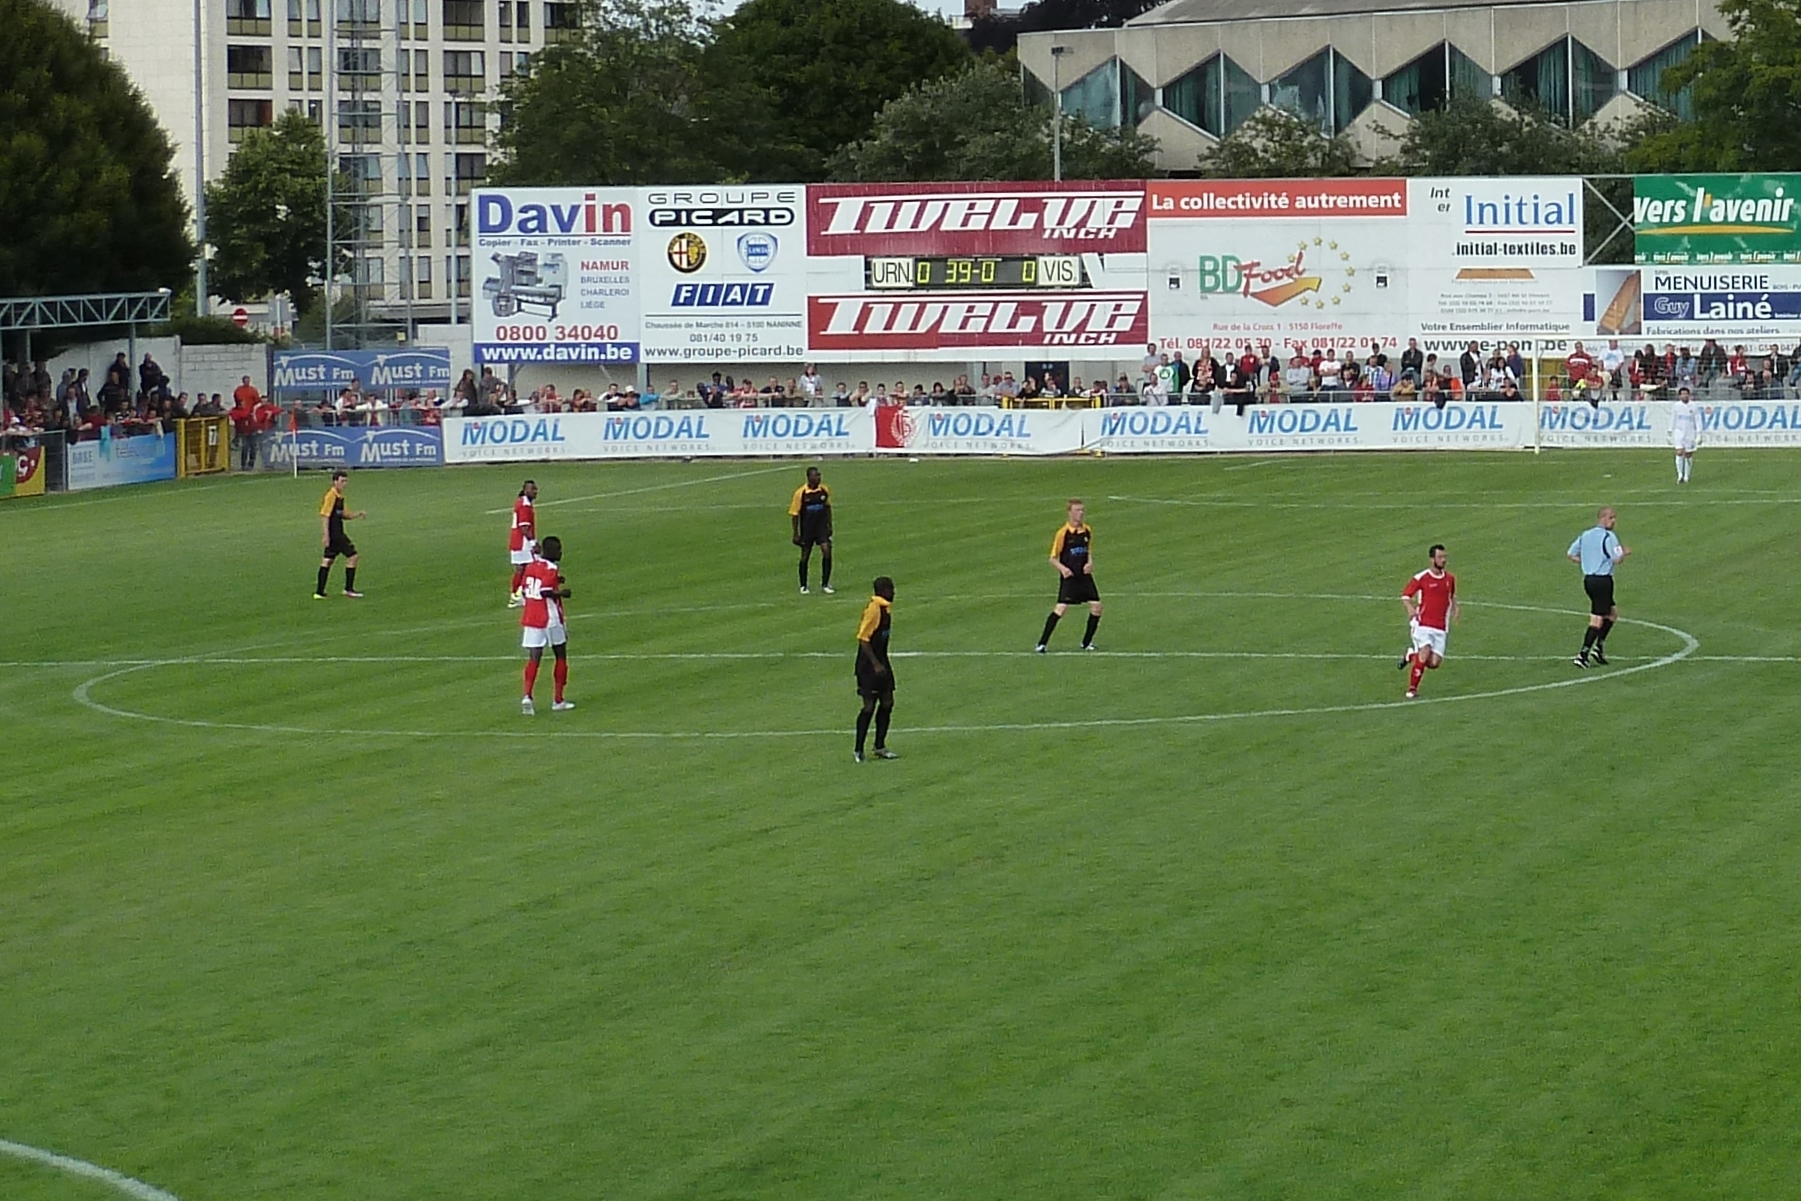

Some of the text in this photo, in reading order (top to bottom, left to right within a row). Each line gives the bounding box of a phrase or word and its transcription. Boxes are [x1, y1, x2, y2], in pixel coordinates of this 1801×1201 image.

[648, 192, 796, 204] GROUPE
[1152, 192, 1401, 209] La collectivité autrement
[1634, 187, 1794, 223] vers l'avenir
[478, 193, 632, 233] Davin
[654, 210, 791, 224] PICARD
[1465, 193, 1575, 225] Initial
[1043, 228, 1117, 239] INCH
[479, 238, 511, 248] Copier
[591, 238, 631, 246] Scanner
[581, 261, 629, 270] NAMUR
[873, 261, 913, 283] URN.
[918, 261, 1035, 283] 0 0
[581, 276, 630, 284] BRUXELLES
[1655, 276, 1769, 290] MENUISERIE
[581, 288, 629, 296] CHARLEROI
[677, 285, 773, 304] FIAT
[1654, 294, 1772, 319] Guy Lainé
[496, 325, 618, 341] 0800 34040
[1213, 323, 1228, 331] Rue
[1243, 322, 1250, 330] la
[1311, 322, 1342, 330] Floreffe
[1450, 322, 1503, 330] Ensemblier
[1506, 322, 1570, 332] Informatique
[1647, 326, 1700, 335] Fabrications
[1703, 327, 1725, 335] dans
[1746, 326, 1779, 334] ateliers
[730, 334, 758, 342] 19 75
[1042, 333, 1117, 344] INCH
[1160, 337, 1397, 349] Tél. Fax 081/22 74
[482, 344, 632, 361] www.davin.be
[645, 346, 803, 358] www.groupe-picard.be
[743, 414, 850, 439] MODAL
[928, 412, 1032, 438] MODAL
[1101, 410, 1209, 436] MODAL
[1248, 407, 1358, 434] MODAL
[1393, 405, 1504, 432] MODAL
[1540, 405, 1652, 432] MODAL
[462, 417, 566, 446] MODAL
[603, 415, 710, 441] MODAL
[360, 440, 409, 462] Must
